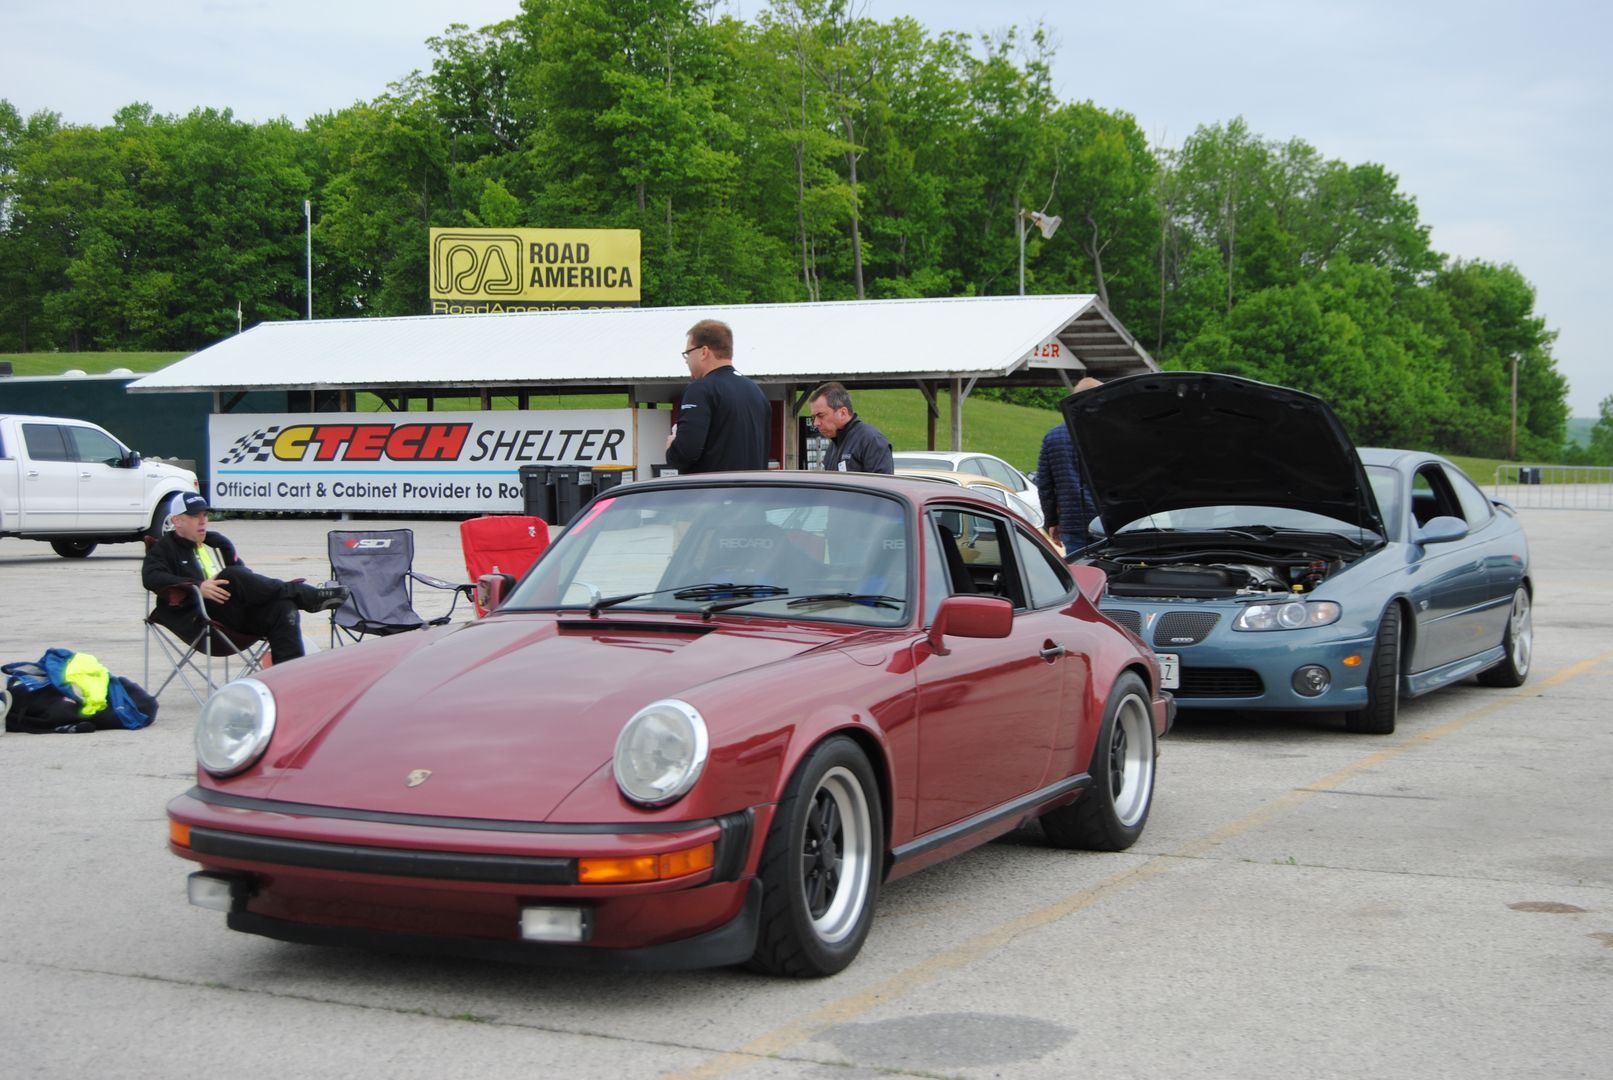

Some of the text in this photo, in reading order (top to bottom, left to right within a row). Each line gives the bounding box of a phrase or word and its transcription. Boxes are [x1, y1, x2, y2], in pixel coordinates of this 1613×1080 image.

[529, 242, 590, 264] ROAD
[529, 266, 633, 288] AMERICA
[432, 301, 633, 315] RoadAmeri
[272, 423, 626, 462] CTECH SHELTER
[216, 482, 271, 497] Official
[277, 482, 311, 497] Cart
[316, 482, 327, 497] &
[332, 482, 397, 498] Cabinet
[403, 482, 471, 499] Provider
[476, 483, 492, 498] to
